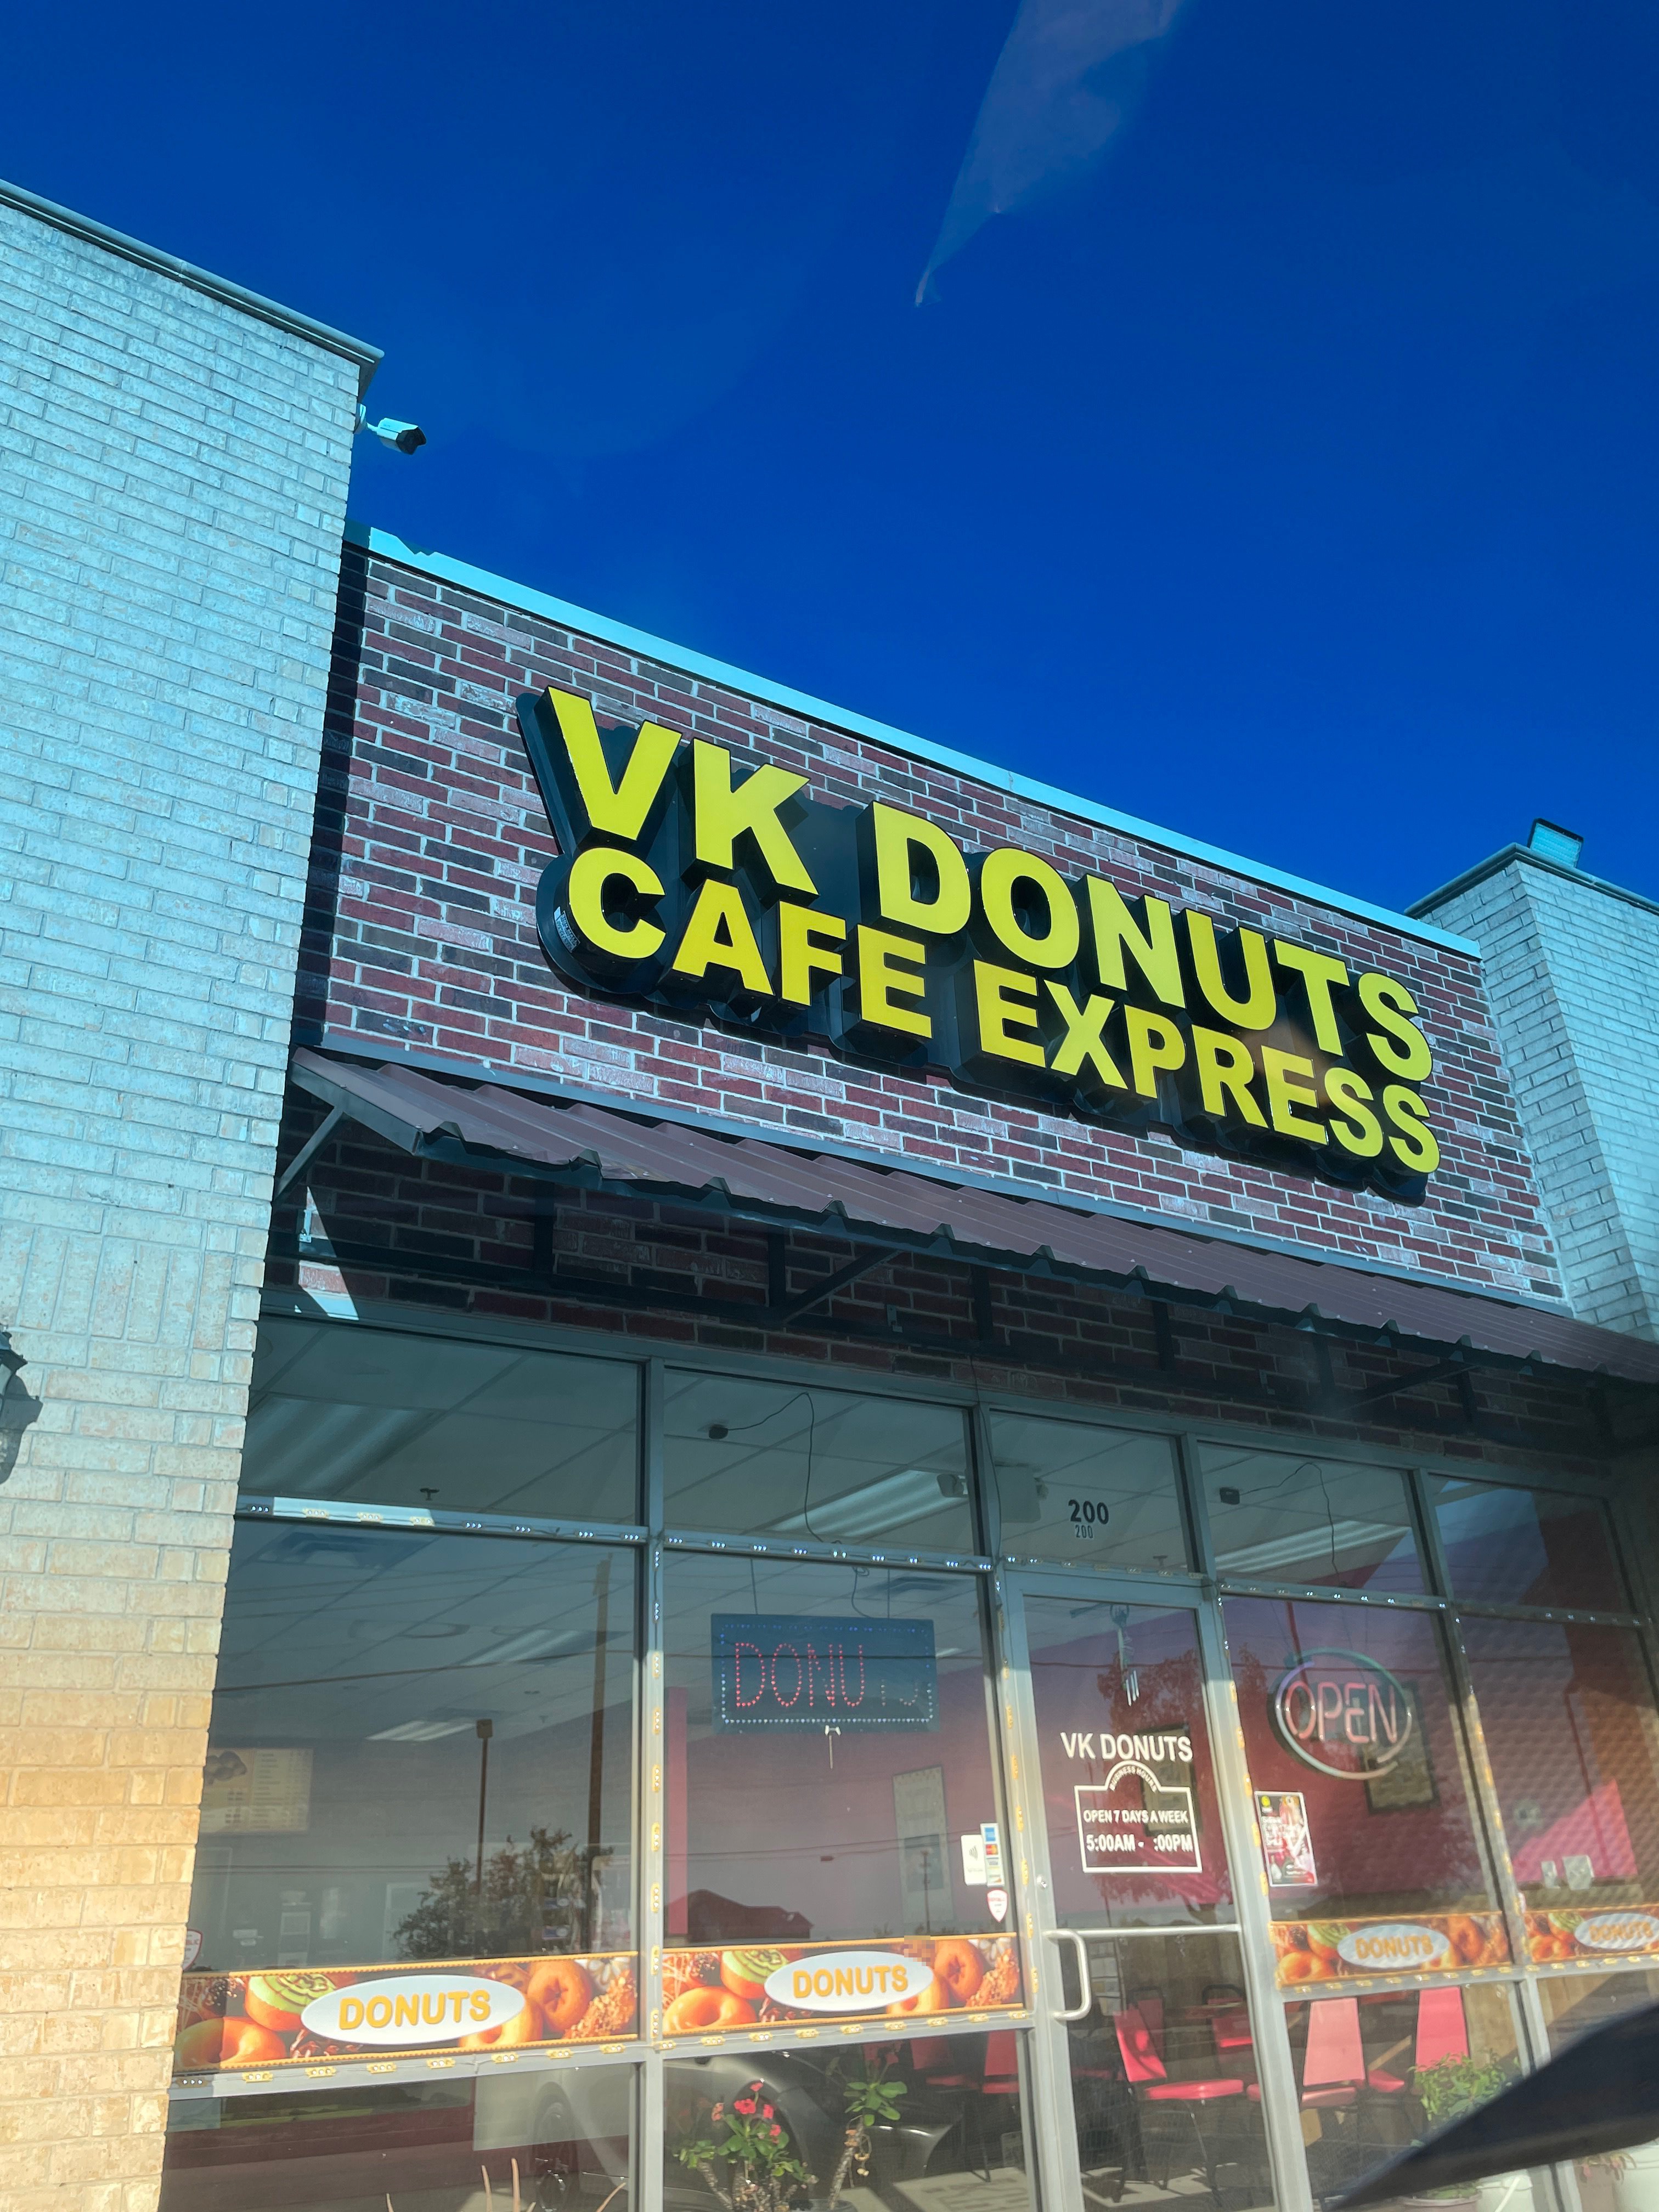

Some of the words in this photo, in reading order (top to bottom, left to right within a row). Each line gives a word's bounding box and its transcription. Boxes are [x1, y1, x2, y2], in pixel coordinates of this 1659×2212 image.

[549, 687, 818, 895] VK
[873, 802, 1433, 1081] DONUTS
[568, 847, 932, 1039] CAFE
[973, 959, 1440, 1173] EXPRESS
[1068, 1499, 1109, 1525] 200
[1075, 1525, 1093, 1538] 200
[1285, 1680, 1397, 1744] OPEN
[1060, 1732, 1096, 1759] VK
[1099, 1733, 1193, 1762] DONUTS
[1109, 1765, 1136, 1792] BUSINESS
[1136, 1765, 1158, 1792] HOURS
[1083, 1809, 1113, 1823] OPEN
[1113, 1810, 1120, 1823] 7
[1121, 1810, 1149, 1824] DAYS
[1150, 1810, 1159, 1823] A
[1159, 1810, 1189, 1824] WEEK
[1086, 1834, 1136, 1852] 5:00AM
[1589, 1921, 1654, 1942] DONUTS
[1355, 1935, 1434, 1959] DONUTS
[793, 1965, 909, 1999] DONUTS
[339, 1990, 492, 2031] DONUTS
